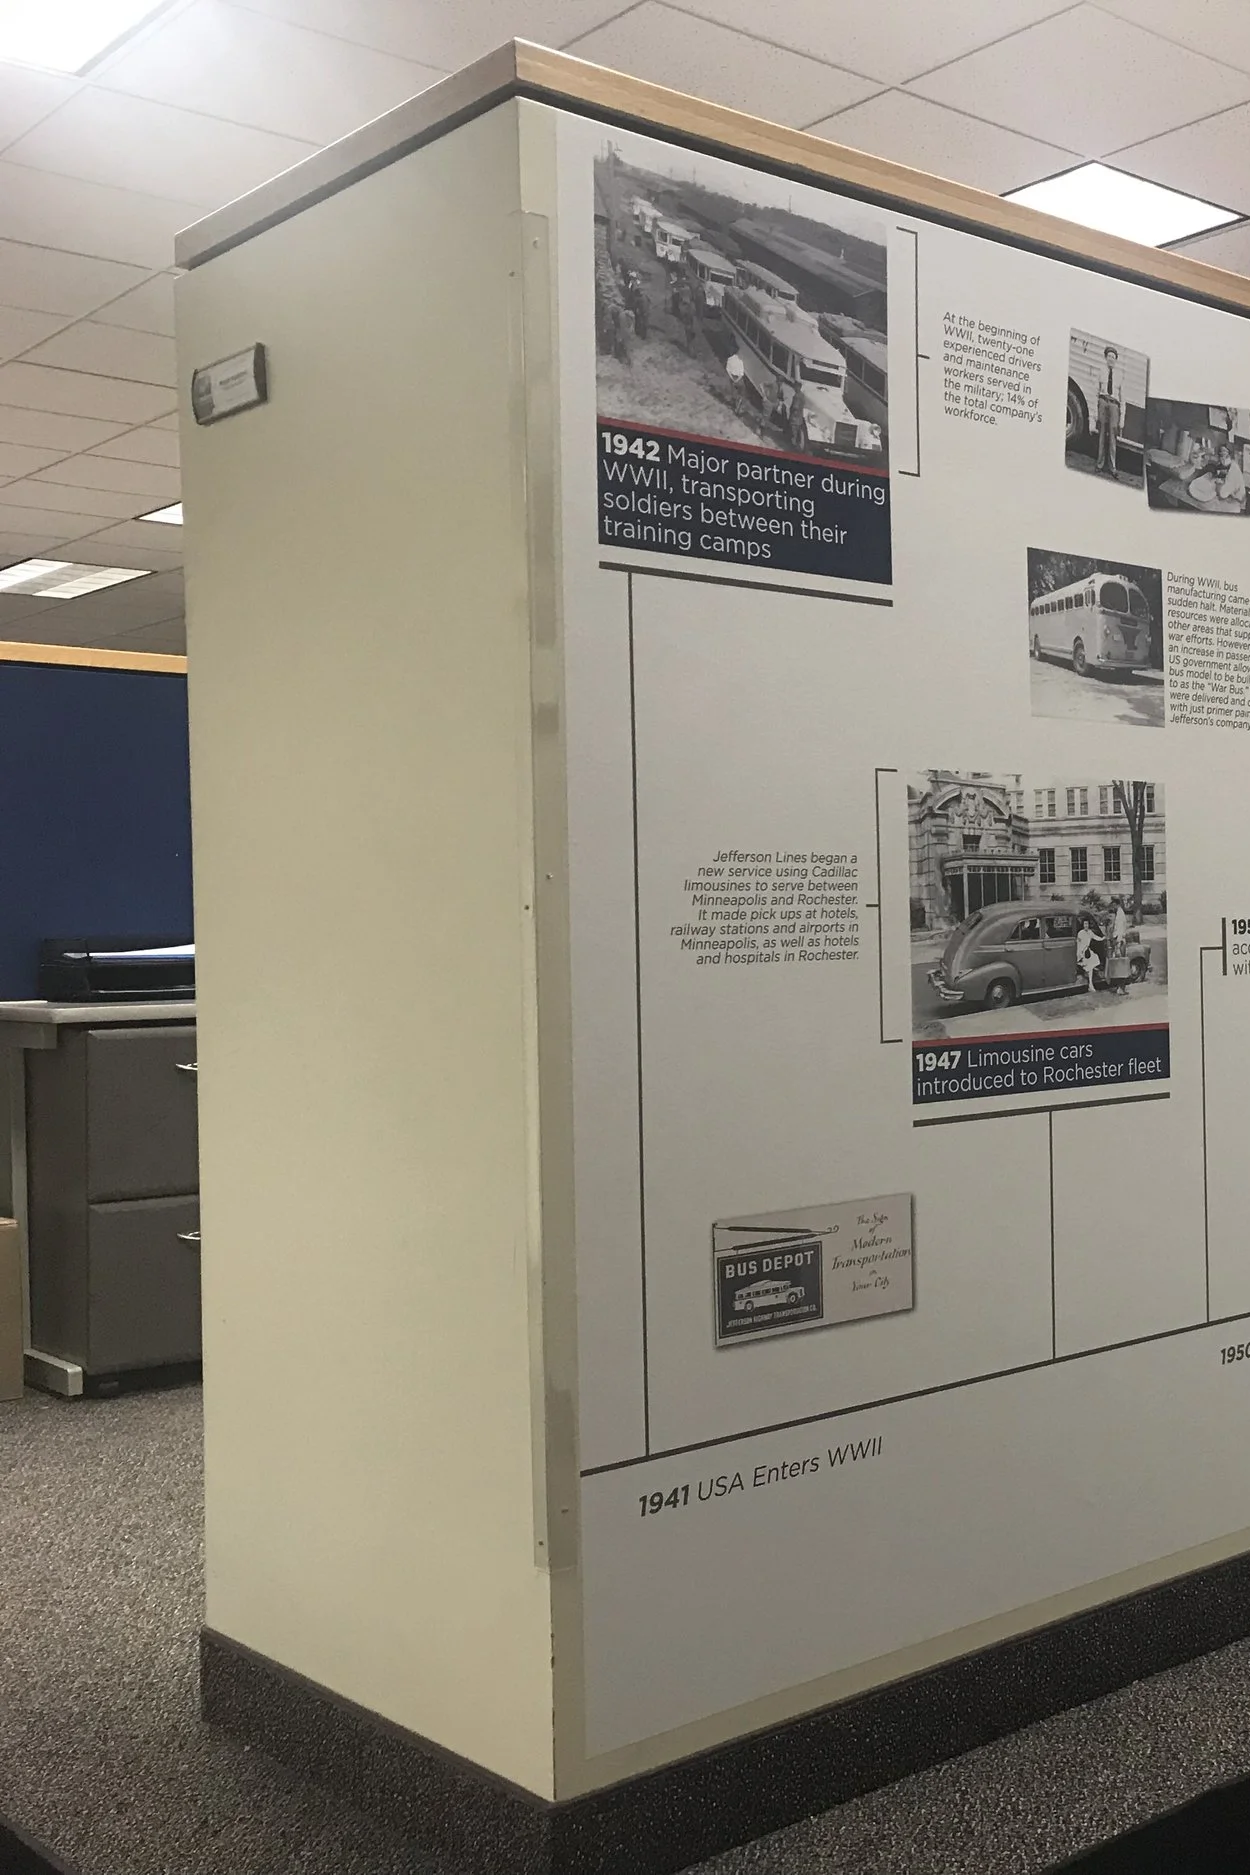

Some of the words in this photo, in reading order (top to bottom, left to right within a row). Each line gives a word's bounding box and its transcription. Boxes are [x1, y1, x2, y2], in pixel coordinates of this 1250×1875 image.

[943, 310, 955, 323] At
[959, 314, 975, 328] the
[978, 320, 1027, 344] beginning
[1030, 335, 1040, 346] of
[944, 324, 974, 342] WWII,
[978, 332, 1034, 356] twenty-one
[943, 340, 1005, 362] experienced
[1008, 354, 1041, 371] drivers
[943, 353, 963, 365] and
[966, 359, 1029, 381] maintenance
[602, 434, 660, 462] 1942
[667, 445, 728, 475] Major
[736, 461, 814, 488] partner
[821, 471, 884, 504] during
[604, 460, 673, 493] WWII,
[681, 473, 814, 518] transporting
[603, 492, 692, 521] soldiers
[700, 504, 793, 536] between
[801, 520, 847, 544] their
[604, 516, 691, 552] training
[699, 535, 771, 561] camps
[1167, 571, 1195, 587] During
[1224, 580, 1238, 592] bus
[1170, 713, 1214, 726] Jefferson's
[698, 868, 724, 877] new
[728, 866, 772, 877] service
[776, 866, 808, 880] using
[812, 866, 858, 878] Cadillac
[713, 851, 771, 863] Jefferson
[776, 852, 807, 863] Lines
[811, 852, 847, 866] began
[850, 855, 857, 864] a
[684, 880, 751, 891] limousines
[755, 880, 768, 891] to
[772, 883, 804, 891] serve
[808, 880, 858, 891] between
[915, 1052, 961, 1072] 1947
[968, 1046, 1054, 1068] Limousine
[1060, 1046, 1092, 1060] cars
[917, 1071, 1014, 1097] introduced
[1021, 1069, 1037, 1086] to
[1043, 1062, 1123, 1084] Rochester
[1129, 1057, 1161, 1076] fleet
[725, 1261, 758, 1279] BUS
[762, 1250, 815, 1273] DEPOT
[640, 1485, 688, 1517] 1941
[697, 1472, 744, 1502] USA
[752, 1457, 819, 1488] Enters
[828, 1437, 881, 1468] WWII
